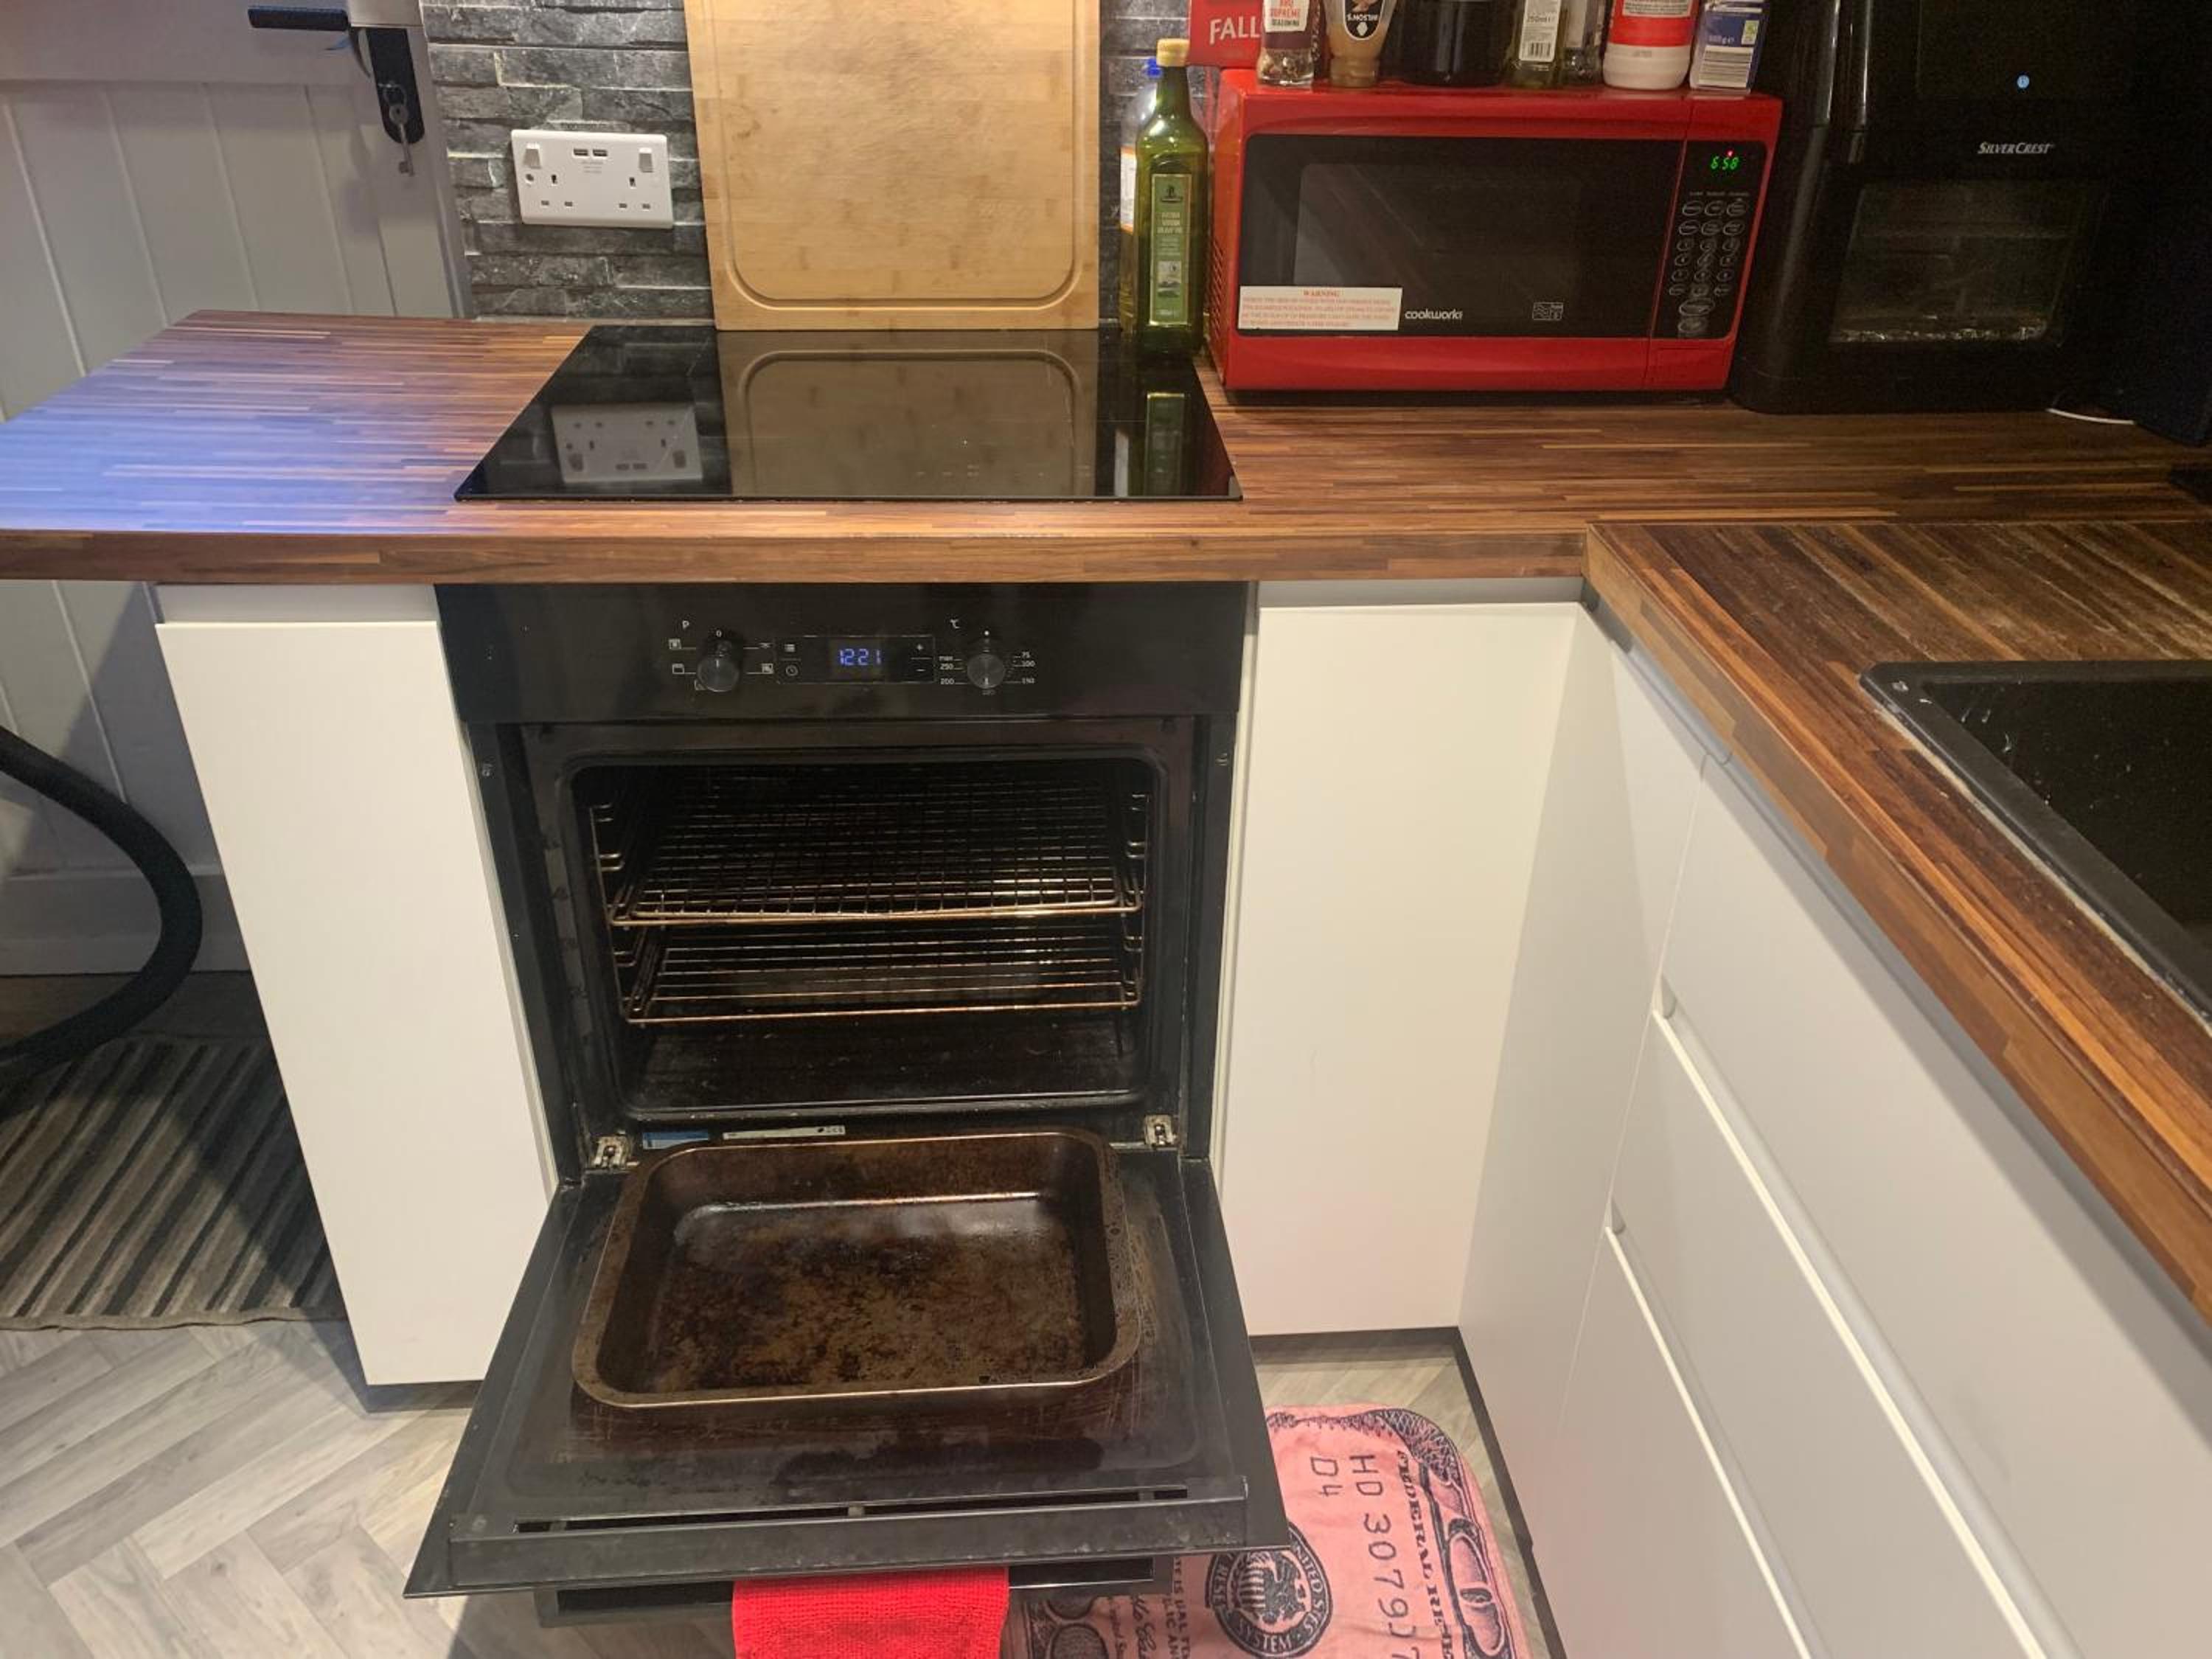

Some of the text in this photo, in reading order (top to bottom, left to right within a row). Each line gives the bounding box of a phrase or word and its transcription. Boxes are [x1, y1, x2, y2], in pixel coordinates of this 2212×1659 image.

[1310, 1456, 1343, 1498] D4
[1349, 1454, 1383, 1496] HD
[1397, 1450, 1433, 1579] FEDERAL
[1291, 1538, 1324, 1593] NITED
